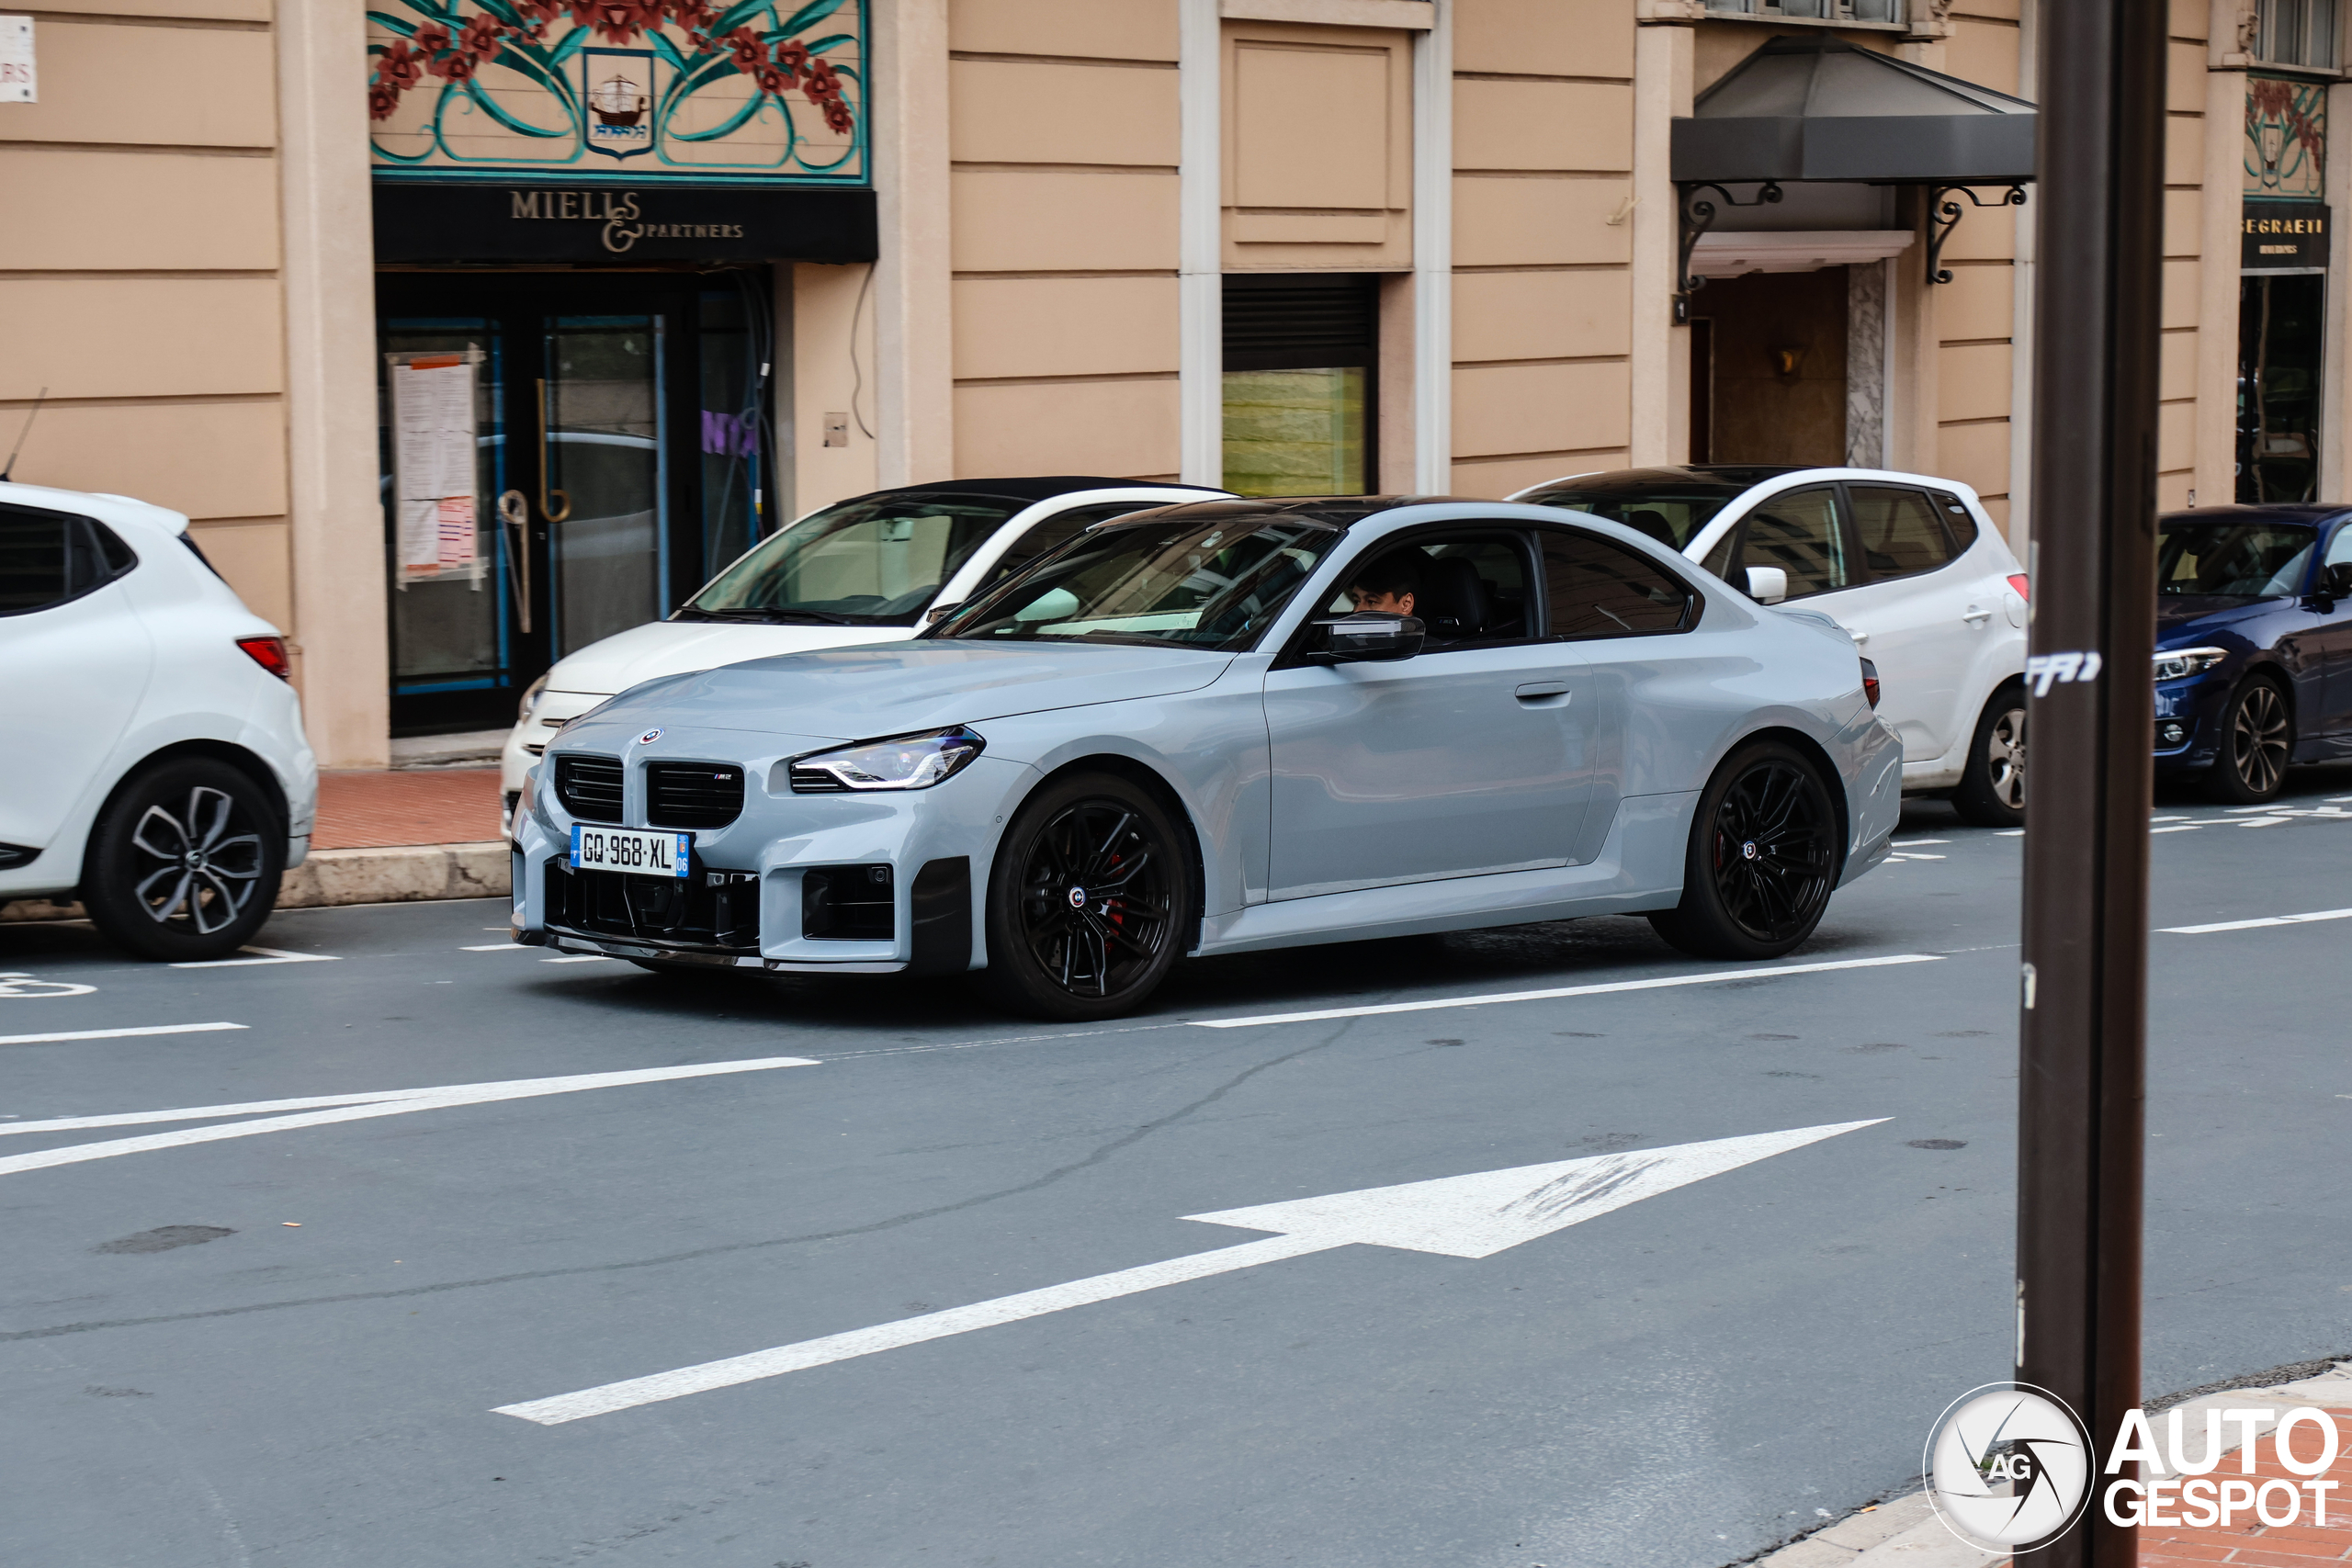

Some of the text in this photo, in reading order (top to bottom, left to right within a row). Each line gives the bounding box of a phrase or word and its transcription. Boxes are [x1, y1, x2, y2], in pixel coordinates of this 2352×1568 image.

[0, 62, 31, 84] RS
[509, 190, 641, 220] MIELLS
[602, 207, 744, 253] & PARTNERS
[583, 832, 673, 870] GQ-968-XL
[676, 857, 688, 873] 06
